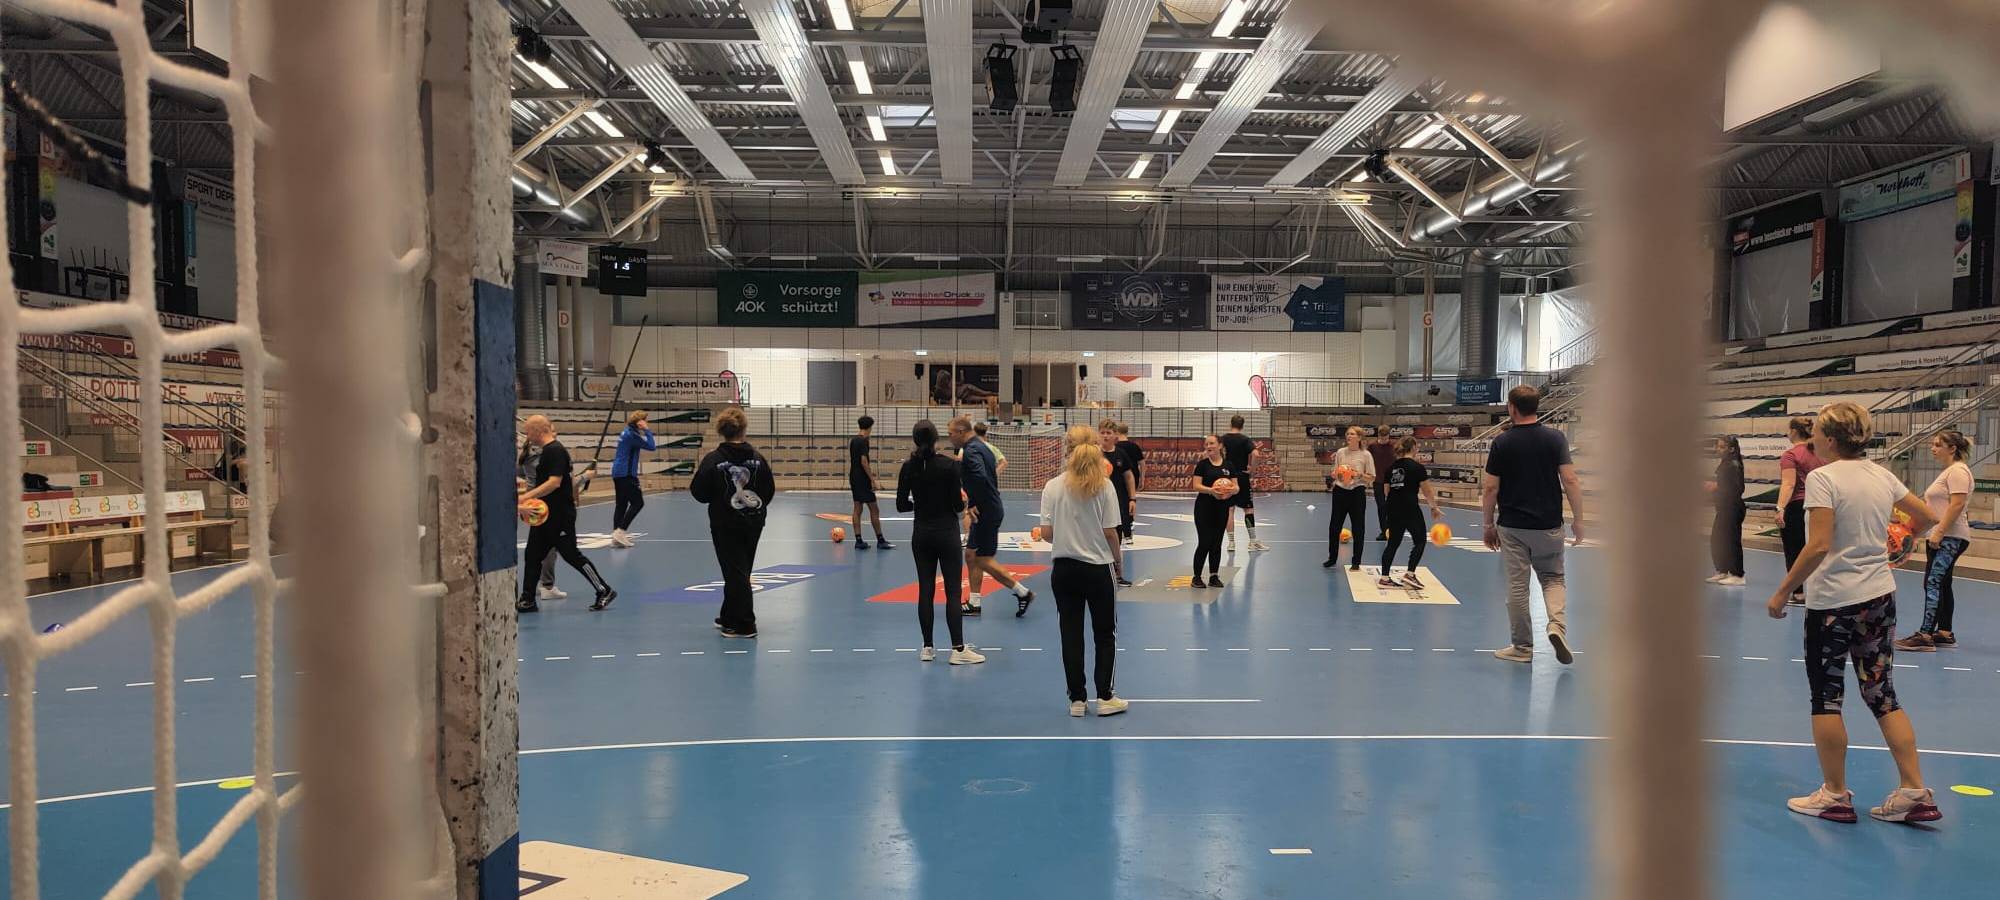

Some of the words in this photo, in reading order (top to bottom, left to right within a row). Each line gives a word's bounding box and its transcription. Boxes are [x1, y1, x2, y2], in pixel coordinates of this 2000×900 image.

[1876, 171, 1926, 194] Nordhoff
[779, 283, 842, 299] Vorsorge
[1216, 283, 1231, 292] NUR
[1232, 283, 1254, 292] EINEN
[1121, 292, 1159, 308] WDI
[1216, 294, 1253, 303] ENTFERNT
[1255, 294, 1270, 303] VON
[735, 301, 766, 313] AOK
[781, 300, 839, 313] schützt!
[1216, 304, 1244, 313] DEINEM
[560, 312, 570, 326] D
[632, 379, 652, 388] Wir
[656, 379, 698, 388] suchen
[701, 380, 730, 388] Dich!
